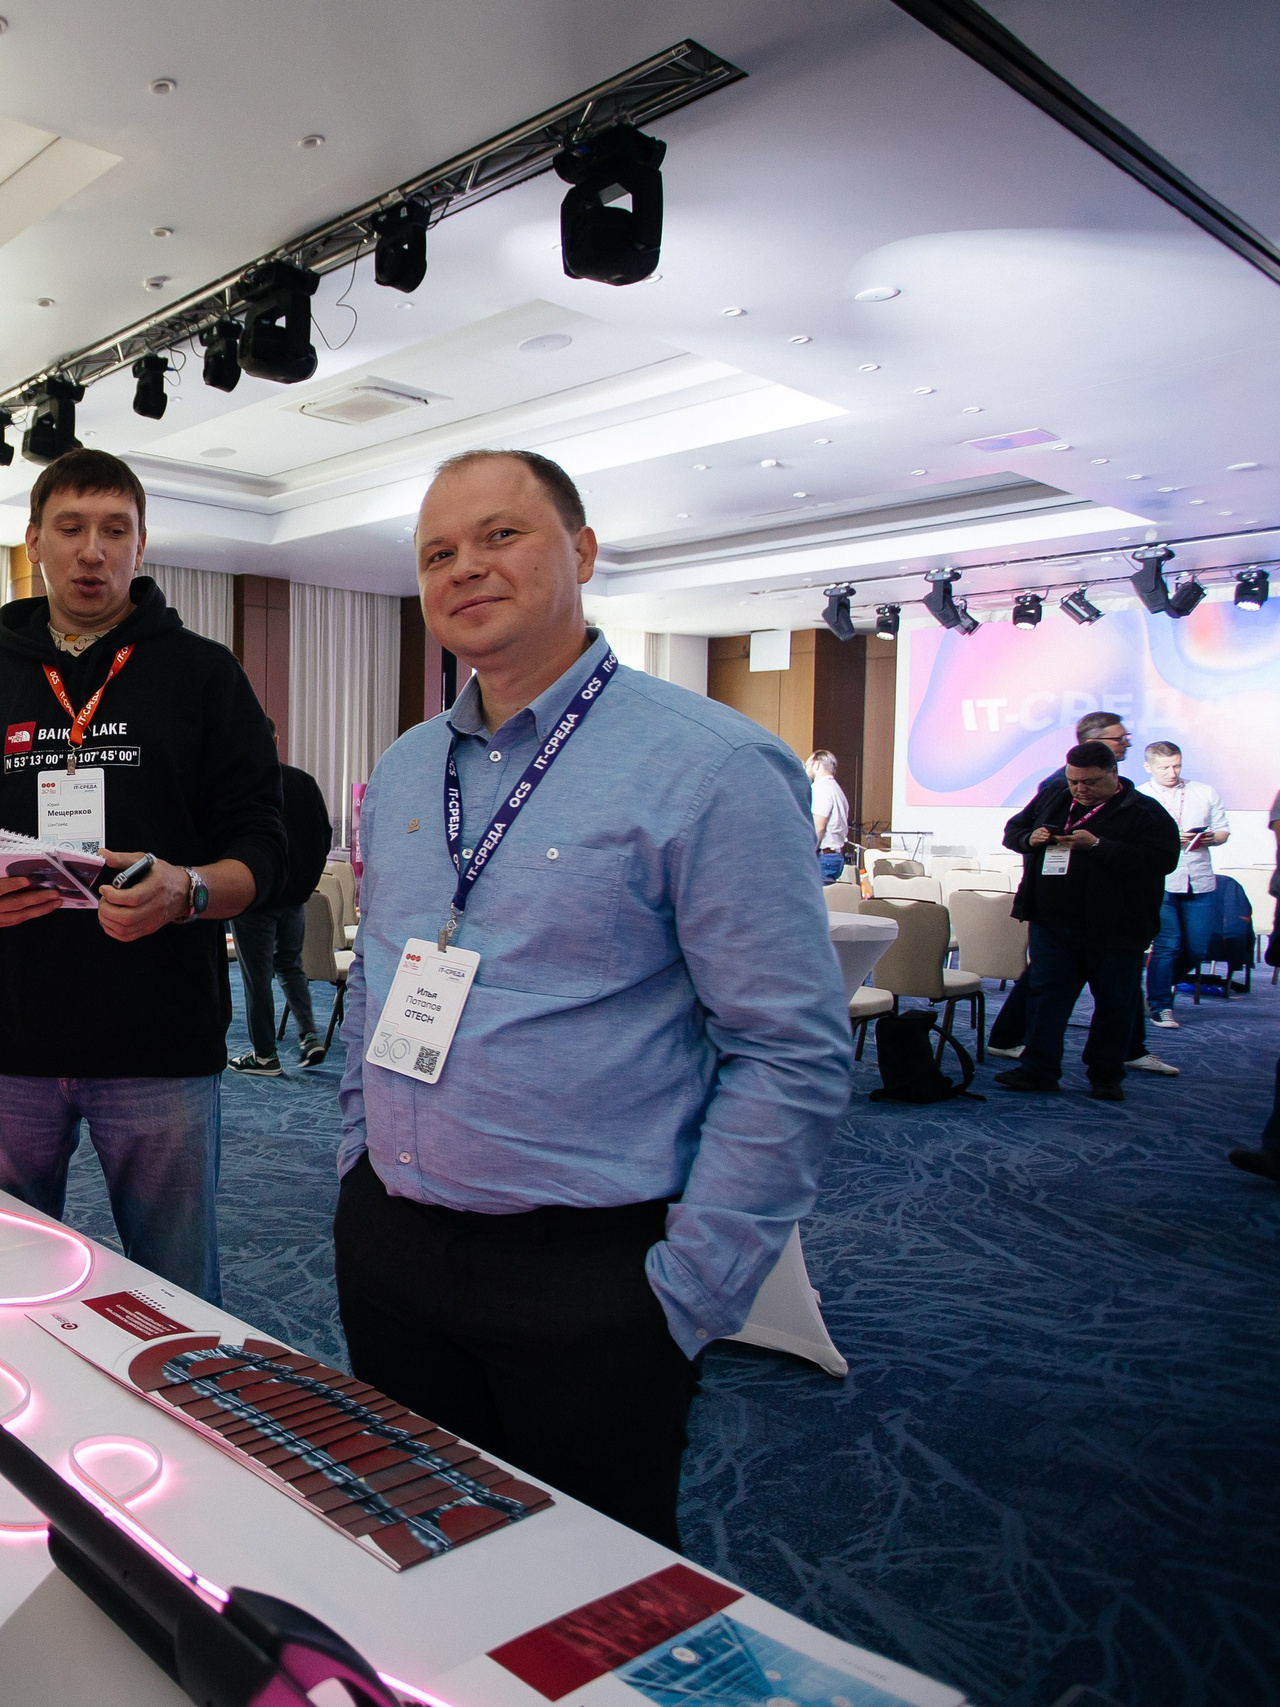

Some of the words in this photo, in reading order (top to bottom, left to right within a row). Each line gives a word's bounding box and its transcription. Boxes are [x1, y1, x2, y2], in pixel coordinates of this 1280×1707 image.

[50, 671, 60, 685] OCS
[581, 677, 602, 700] OCS
[38, 728, 87, 741] BAIKL
[92, 723, 128, 737] LAKE
[533, 712, 579, 771] IT-СРЕДА
[6, 758, 12, 770] N
[509, 781, 532, 808] OCS
[47, 809, 92, 817] Мещеряков
[448, 787, 460, 841] IT-СРЕДА
[466, 822, 507, 882] IT-СРЕДА
[417, 986, 438, 999] Илья
[405, 995, 442, 1012] Потапов
[404, 1009, 435, 1024] QTECH
